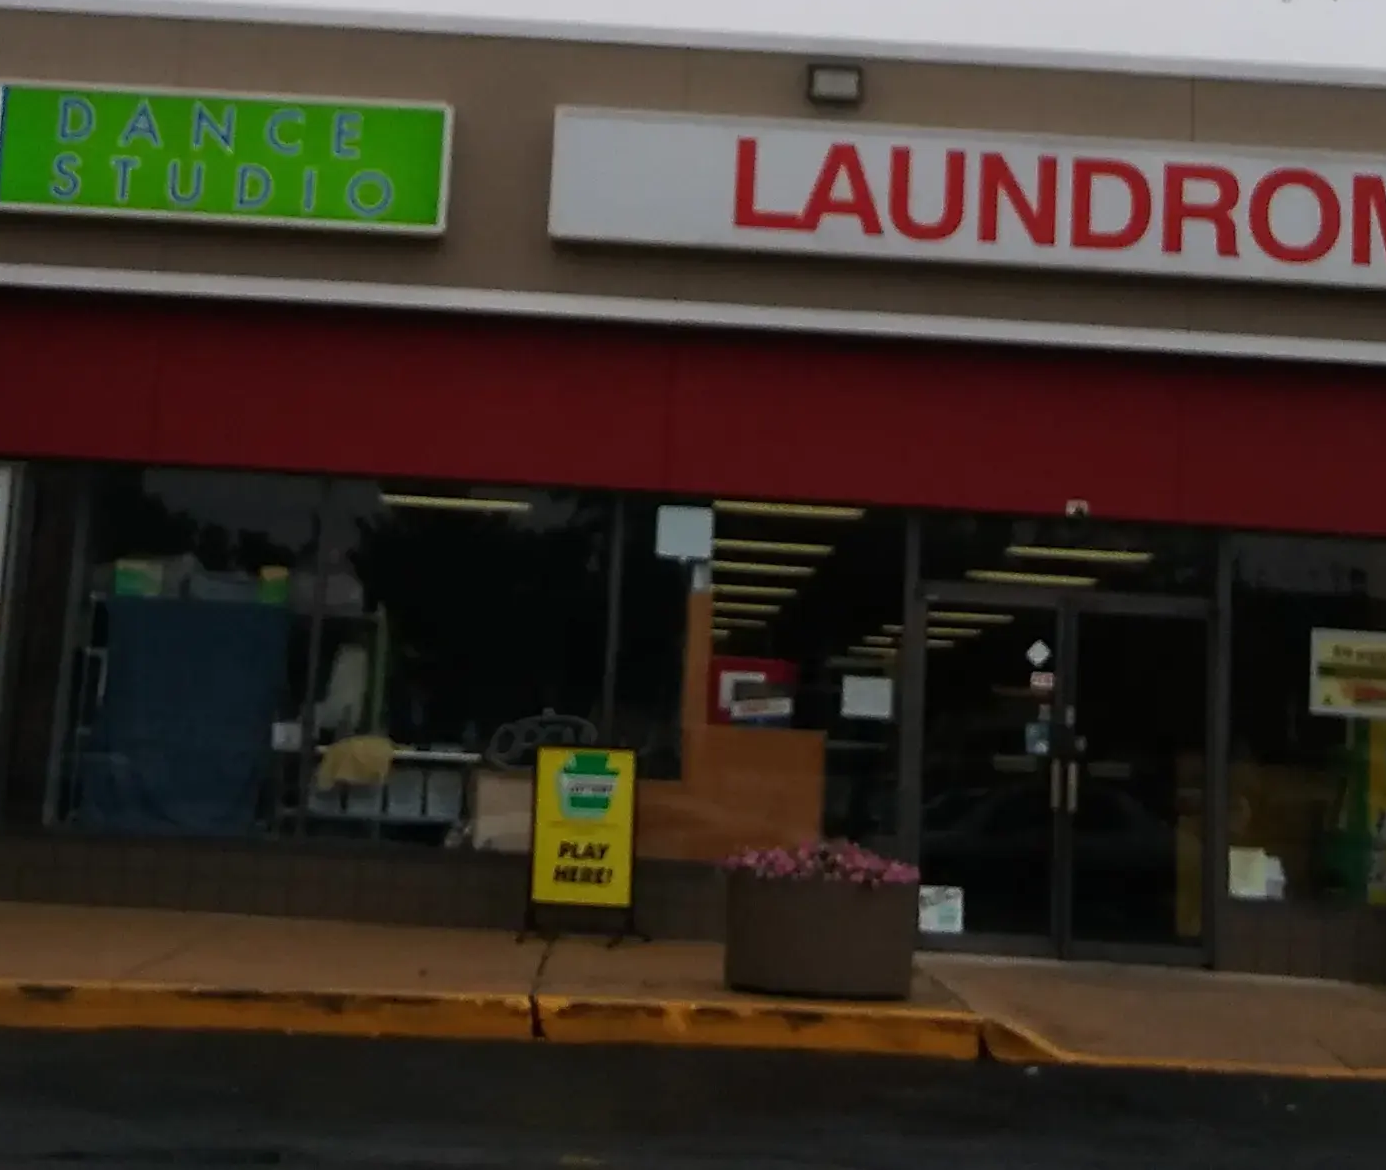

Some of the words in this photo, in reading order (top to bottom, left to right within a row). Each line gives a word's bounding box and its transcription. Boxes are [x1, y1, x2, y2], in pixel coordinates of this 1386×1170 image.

[56, 96, 363, 160] DANCE
[49, 154, 395, 218] STUDIO
[558, 841, 610, 860] PLAY
[553, 865, 613, 884] HERE!
